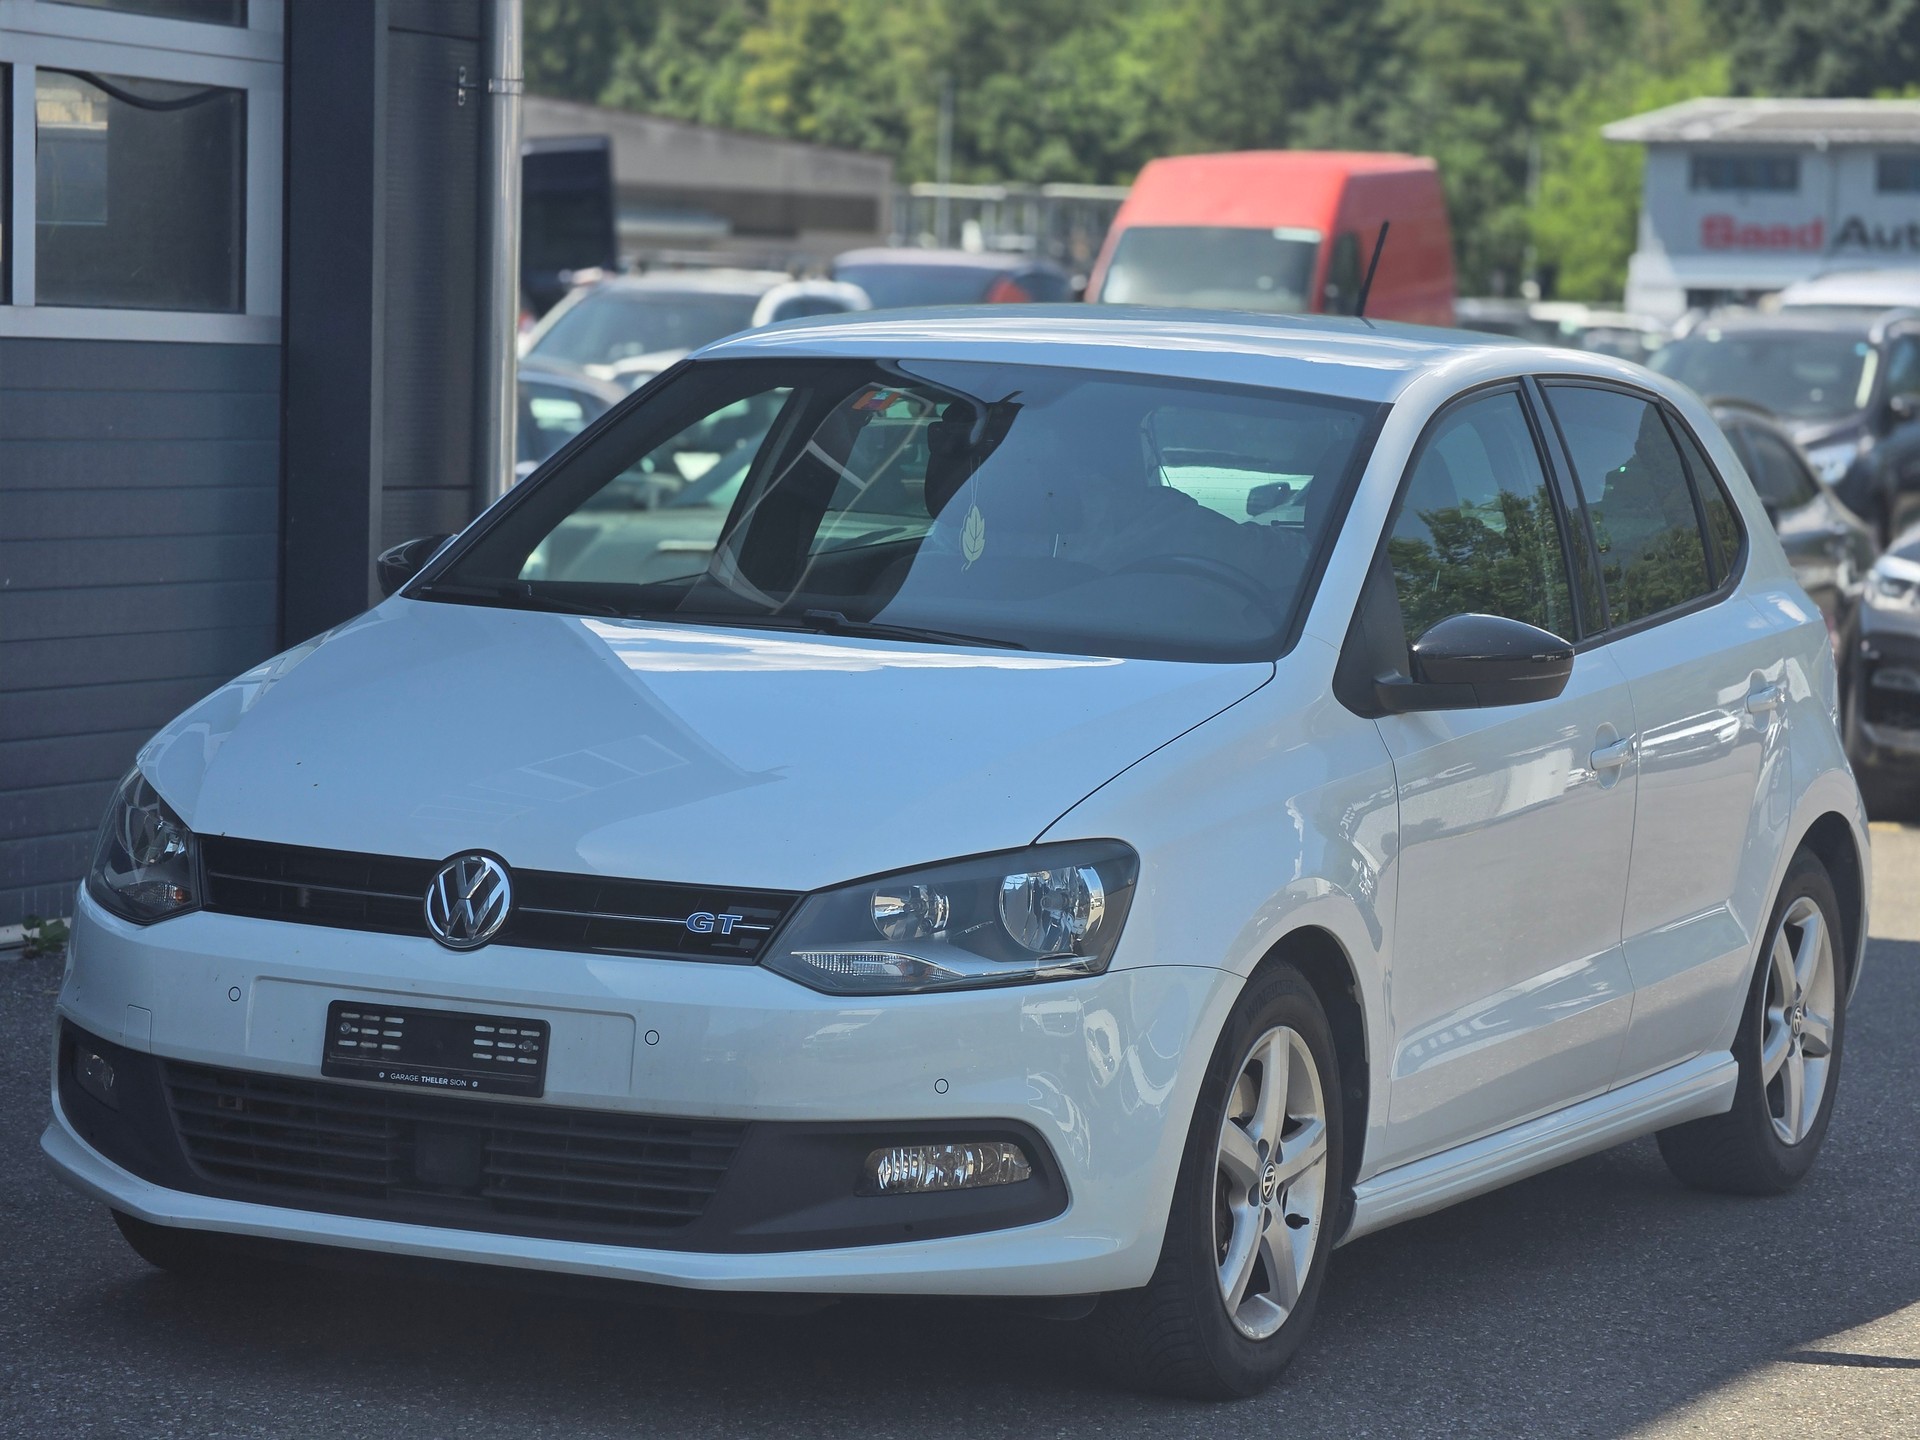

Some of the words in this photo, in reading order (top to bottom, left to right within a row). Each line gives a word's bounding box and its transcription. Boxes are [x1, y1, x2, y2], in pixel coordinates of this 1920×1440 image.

[686, 911, 743, 935] GT
[390, 1072, 419, 1082] GARAGE
[421, 1076, 449, 1085] THELER
[449, 1079, 467, 1087] SION
